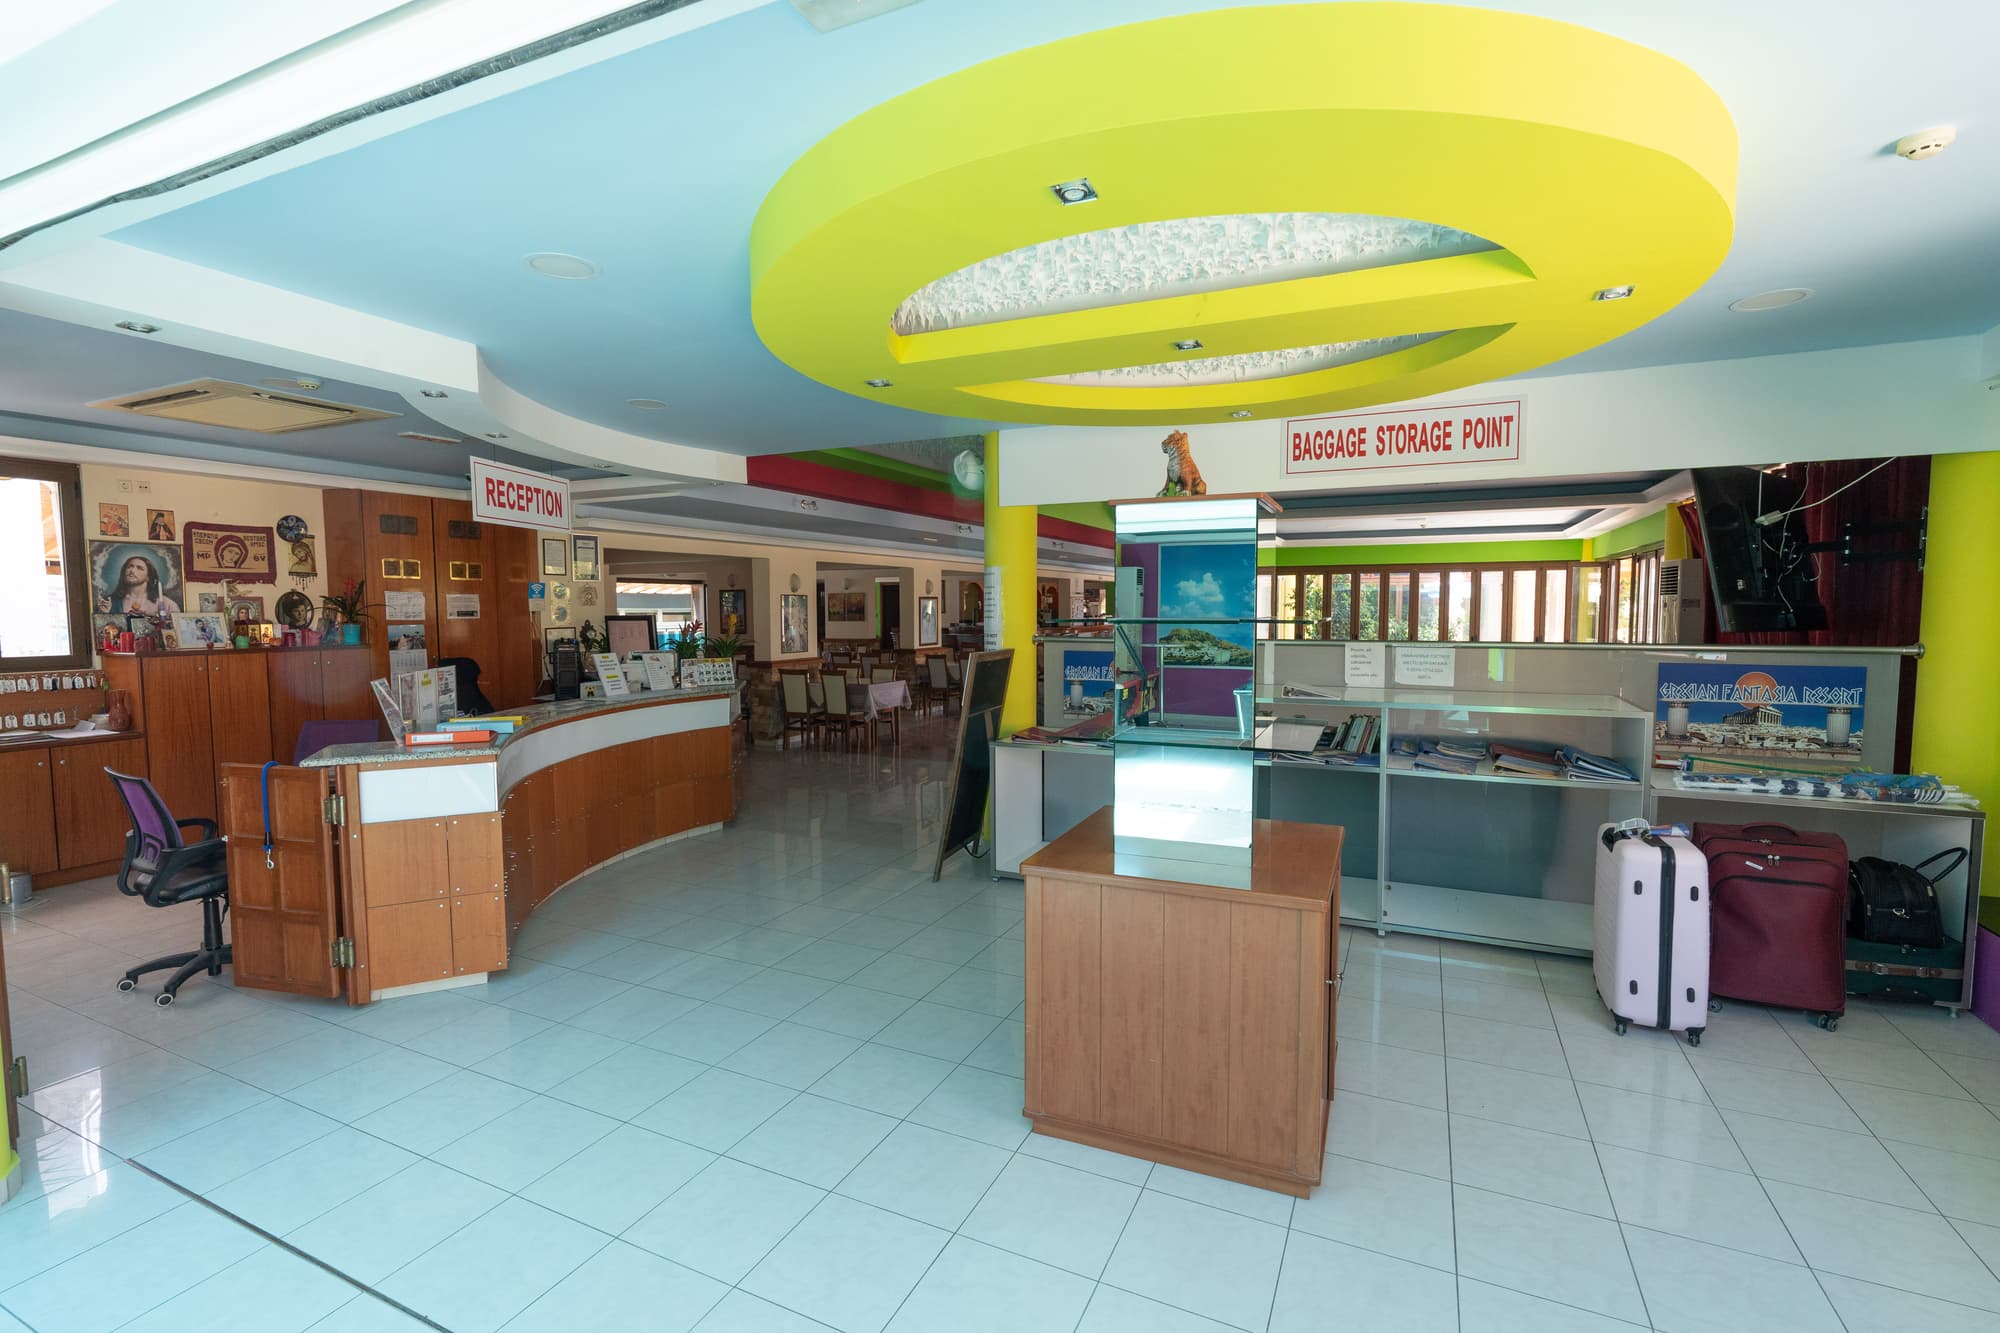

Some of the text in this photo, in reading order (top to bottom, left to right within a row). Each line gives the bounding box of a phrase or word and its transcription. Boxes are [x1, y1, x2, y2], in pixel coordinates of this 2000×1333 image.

[1292, 415, 1514, 461] BAGGAGE STORAGE POINT
[485, 476, 563, 519] RECEPTION
[1659, 682, 1863, 706] GRECIAN FANTASIA RESORT
